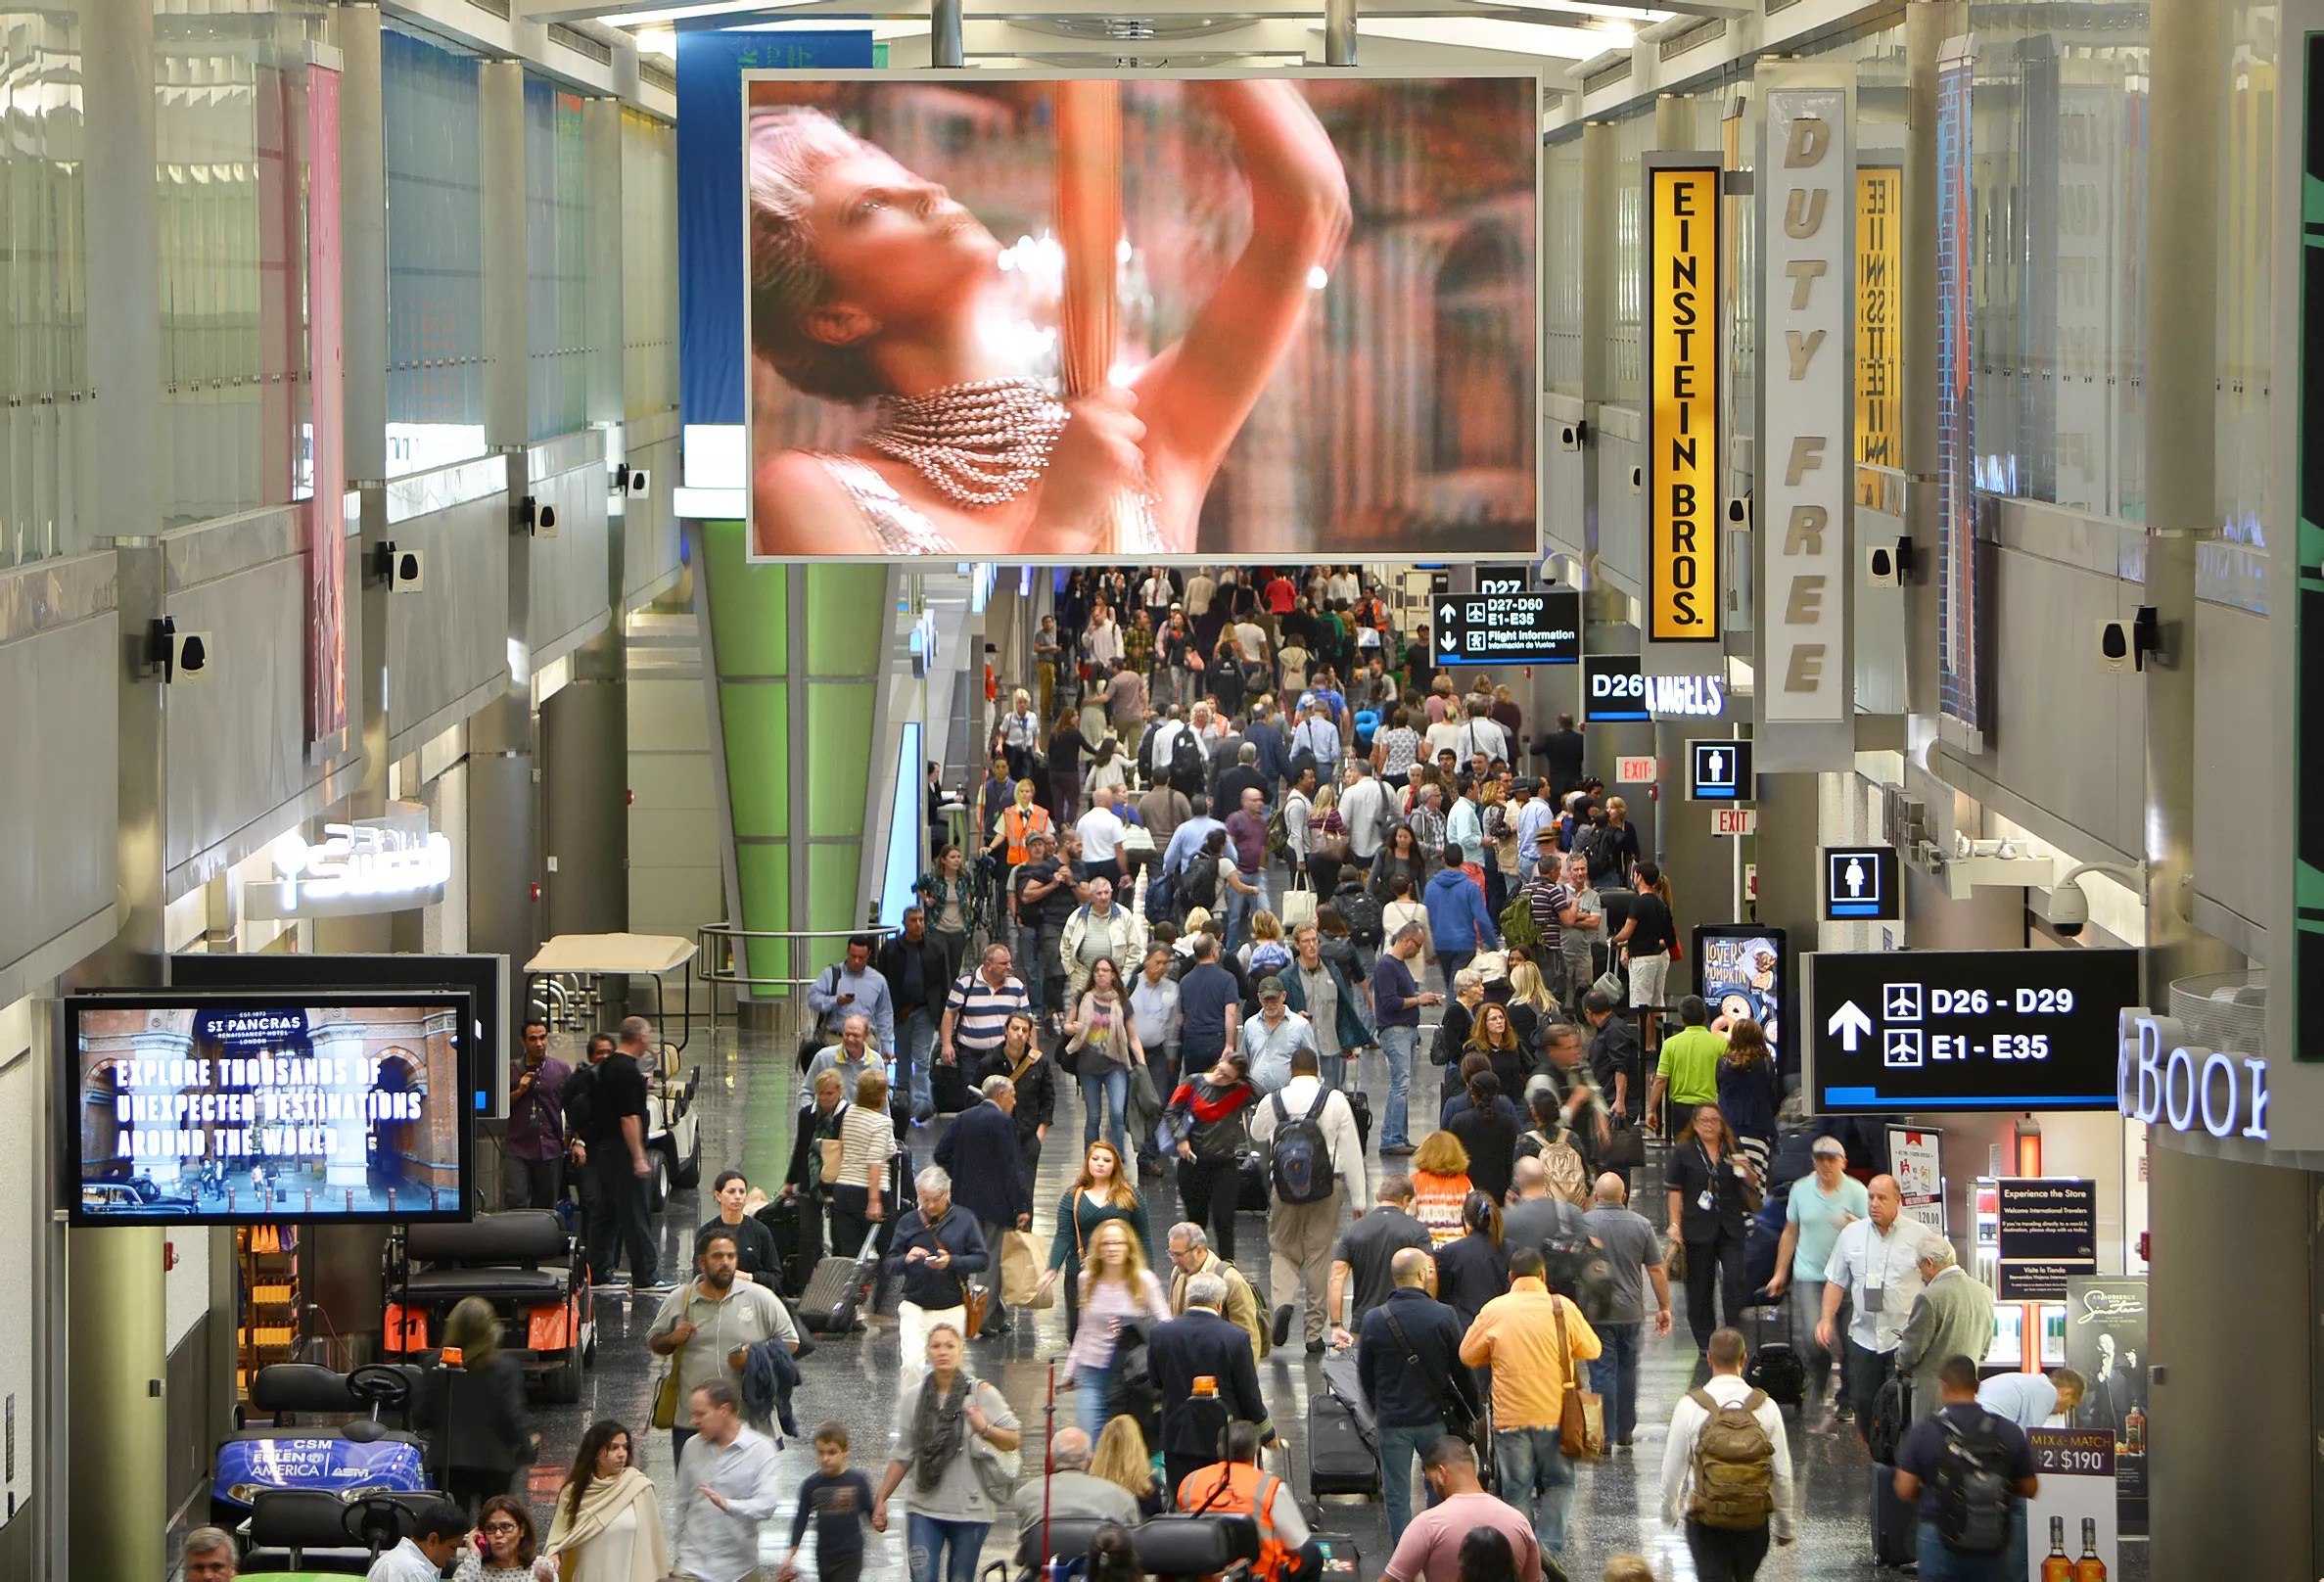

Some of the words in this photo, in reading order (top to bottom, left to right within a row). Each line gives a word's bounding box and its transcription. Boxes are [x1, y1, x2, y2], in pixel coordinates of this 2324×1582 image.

[1784, 117, 1829, 381] DUTY
[1672, 181, 1697, 472] EINSTEIN
[1672, 484, 1703, 625] BROS.
[1784, 437, 1828, 692] FREE
[1481, 580, 1521, 594] D27
[1488, 598, 1544, 611] D27-D60
[1488, 613, 1535, 626] E1-E35
[1488, 630, 1516, 642] Flight
[1518, 629, 1575, 641] Information
[1592, 674, 1644, 697] D26
[1624, 760, 1649, 779] EXIT
[1719, 812, 1747, 832] EXIT
[1704, 964, 1746, 984] PUMPKIN
[1931, 989, 1988, 1014] D26
[2016, 988, 2073, 1013] D29
[228, 1017, 301, 1032] PANCRAS
[1931, 1036, 1966, 1059] E1
[1992, 1035, 2048, 1059] E35
[116, 1059, 210, 1088] EXPLORE
[218, 1057, 347, 1087] THOUSANDS
[355, 1057, 382, 1085] OF
[116, 1093, 256, 1122] UNEXPECTED
[264, 1092, 421, 1121] DESTINATIONS
[117, 1129, 207, 1157] AROUND
[214, 1128, 255, 1156] THE
[2004, 1188, 2049, 1199] Experience
[2050, 1188, 2063, 1197] the
[2065, 1188, 2087, 1198] Store
[2077, 1289, 2144, 1324] Sinatra
[294, 1440, 333, 1450] CSM
[2030, 1435, 2055, 1446] MIX
[2056, 1436, 2066, 1446] &
[2069, 1436, 2112, 1448] MATCH
[2043, 1450, 2054, 1467] 2
[251, 1465, 319, 1476] AMERICA
